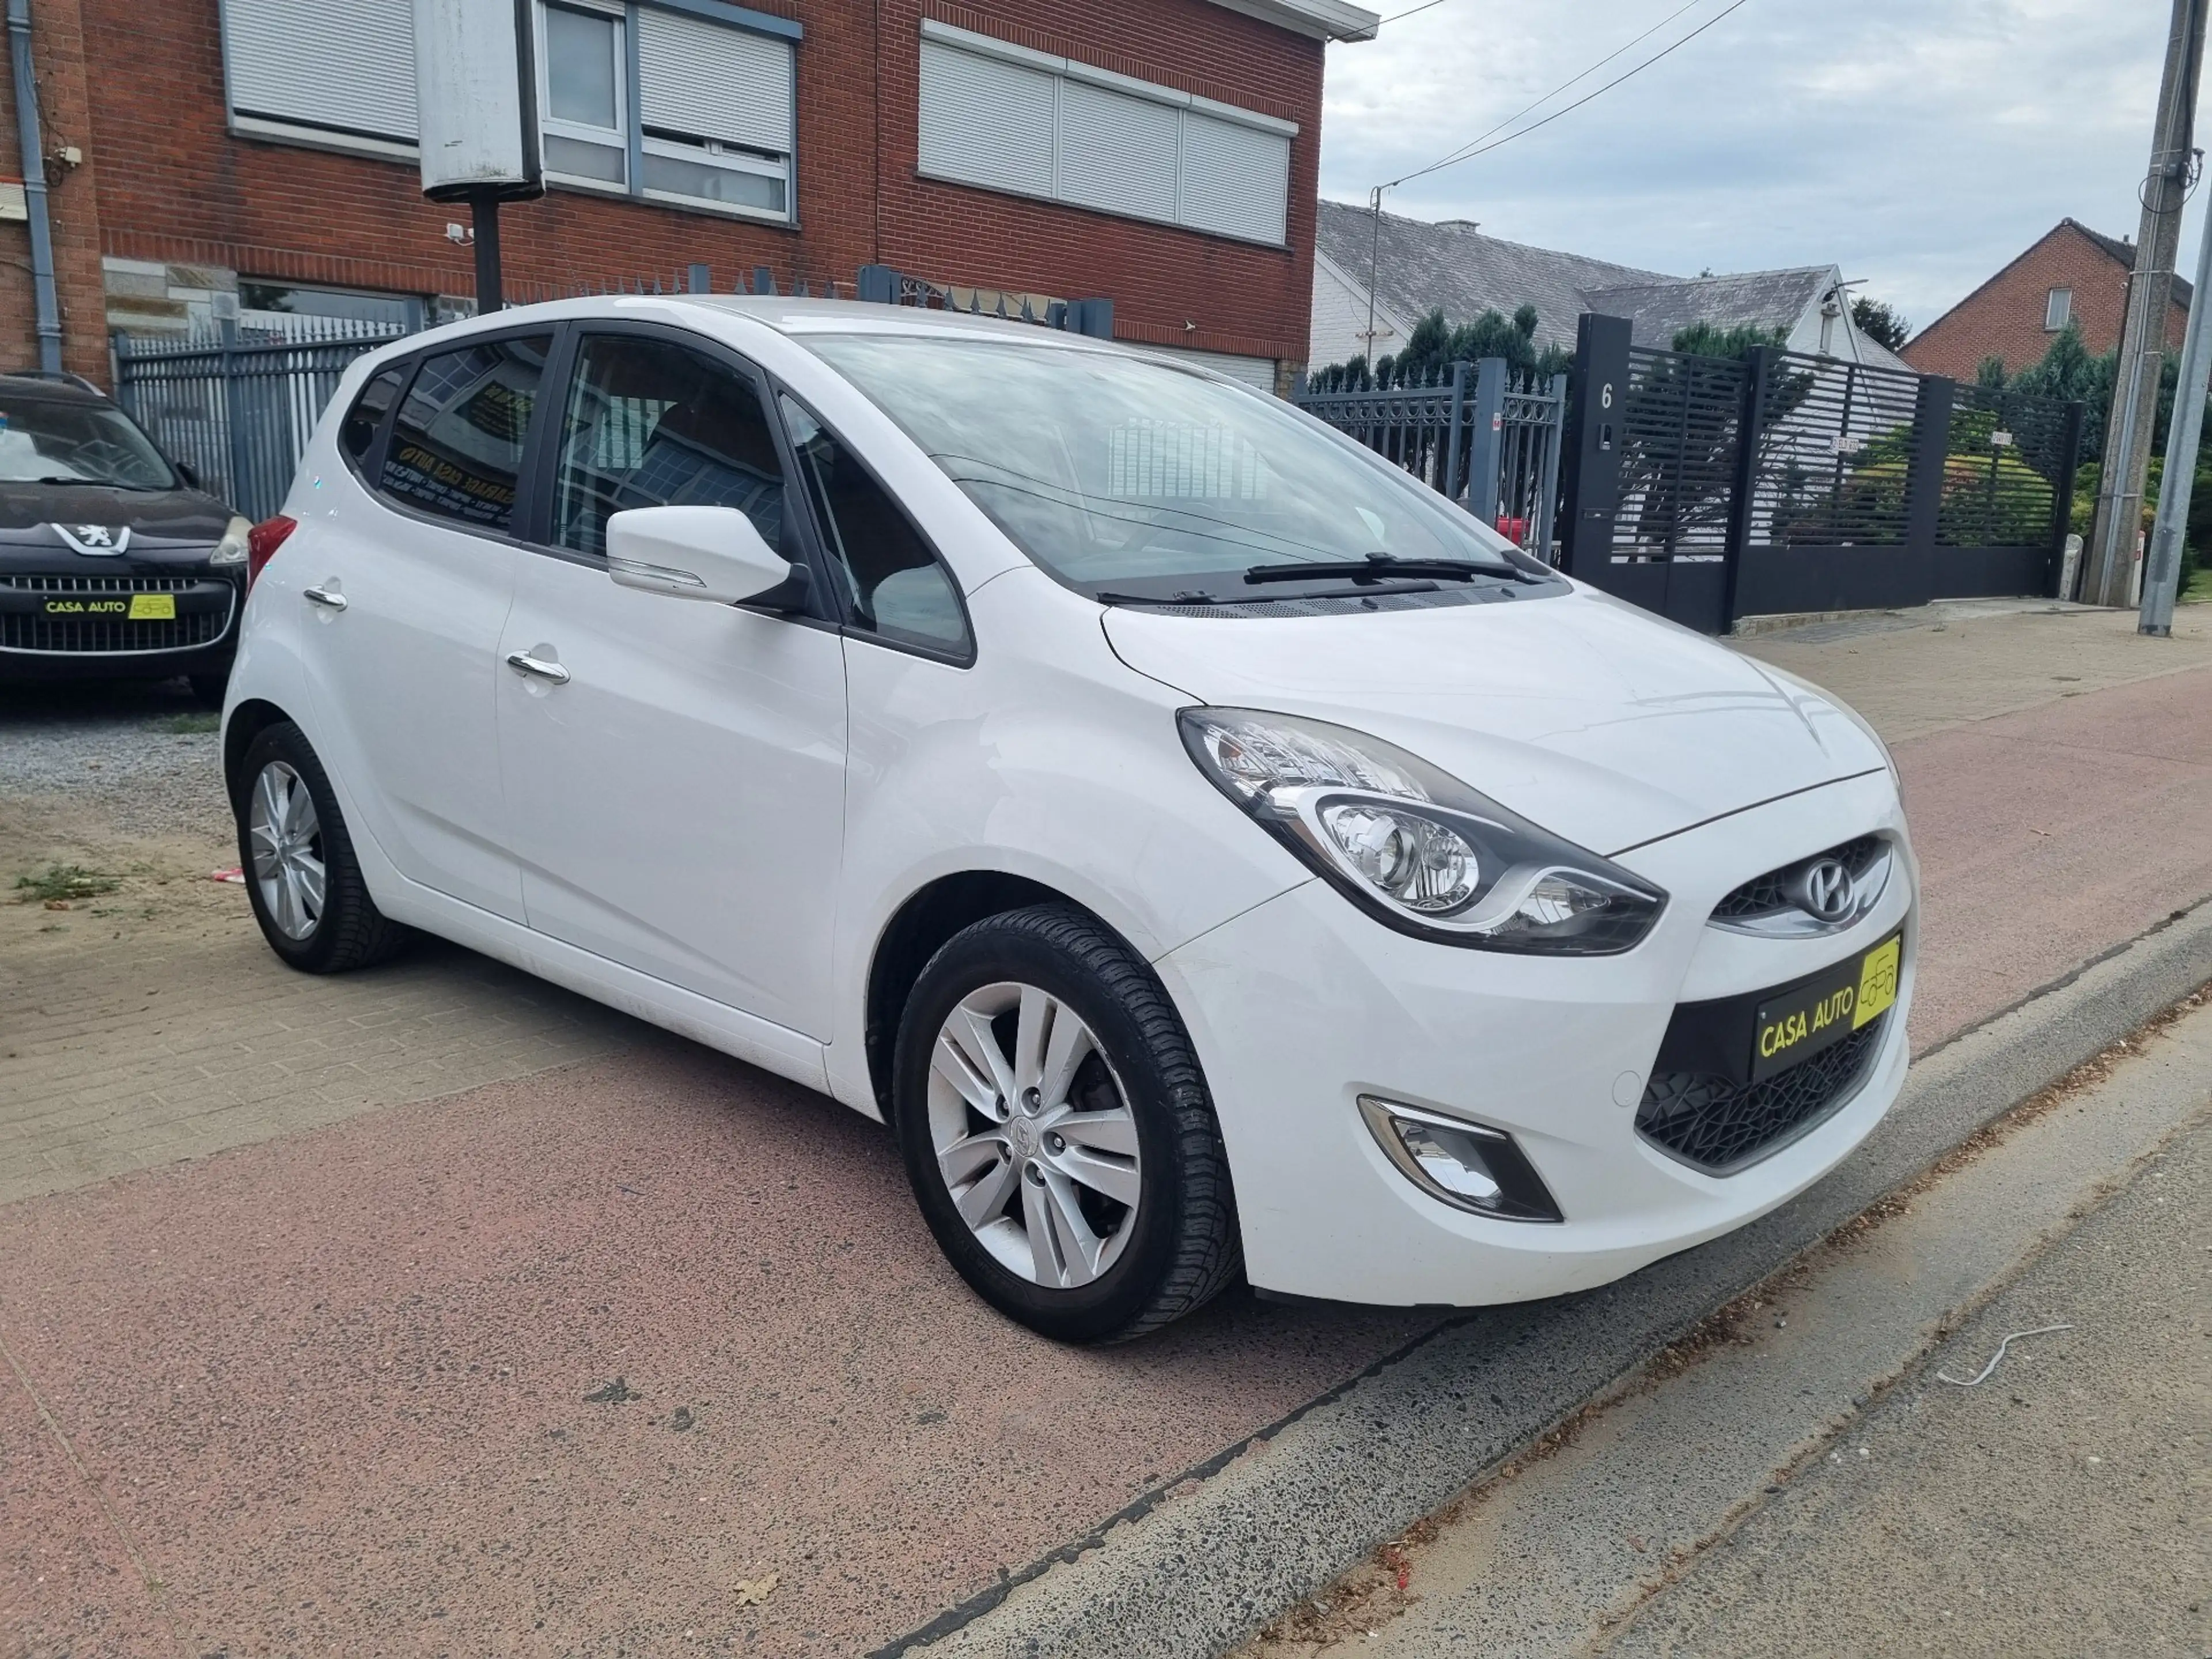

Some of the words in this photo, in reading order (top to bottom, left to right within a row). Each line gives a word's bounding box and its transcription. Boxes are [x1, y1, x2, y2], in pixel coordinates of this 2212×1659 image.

[1603, 382, 1612, 408] 6
[46, 602, 84, 612] CASA
[89, 602, 126, 612] AUTO
[1760, 1010, 1808, 1058] CASA
[1812, 986, 1854, 1033] AUTO
